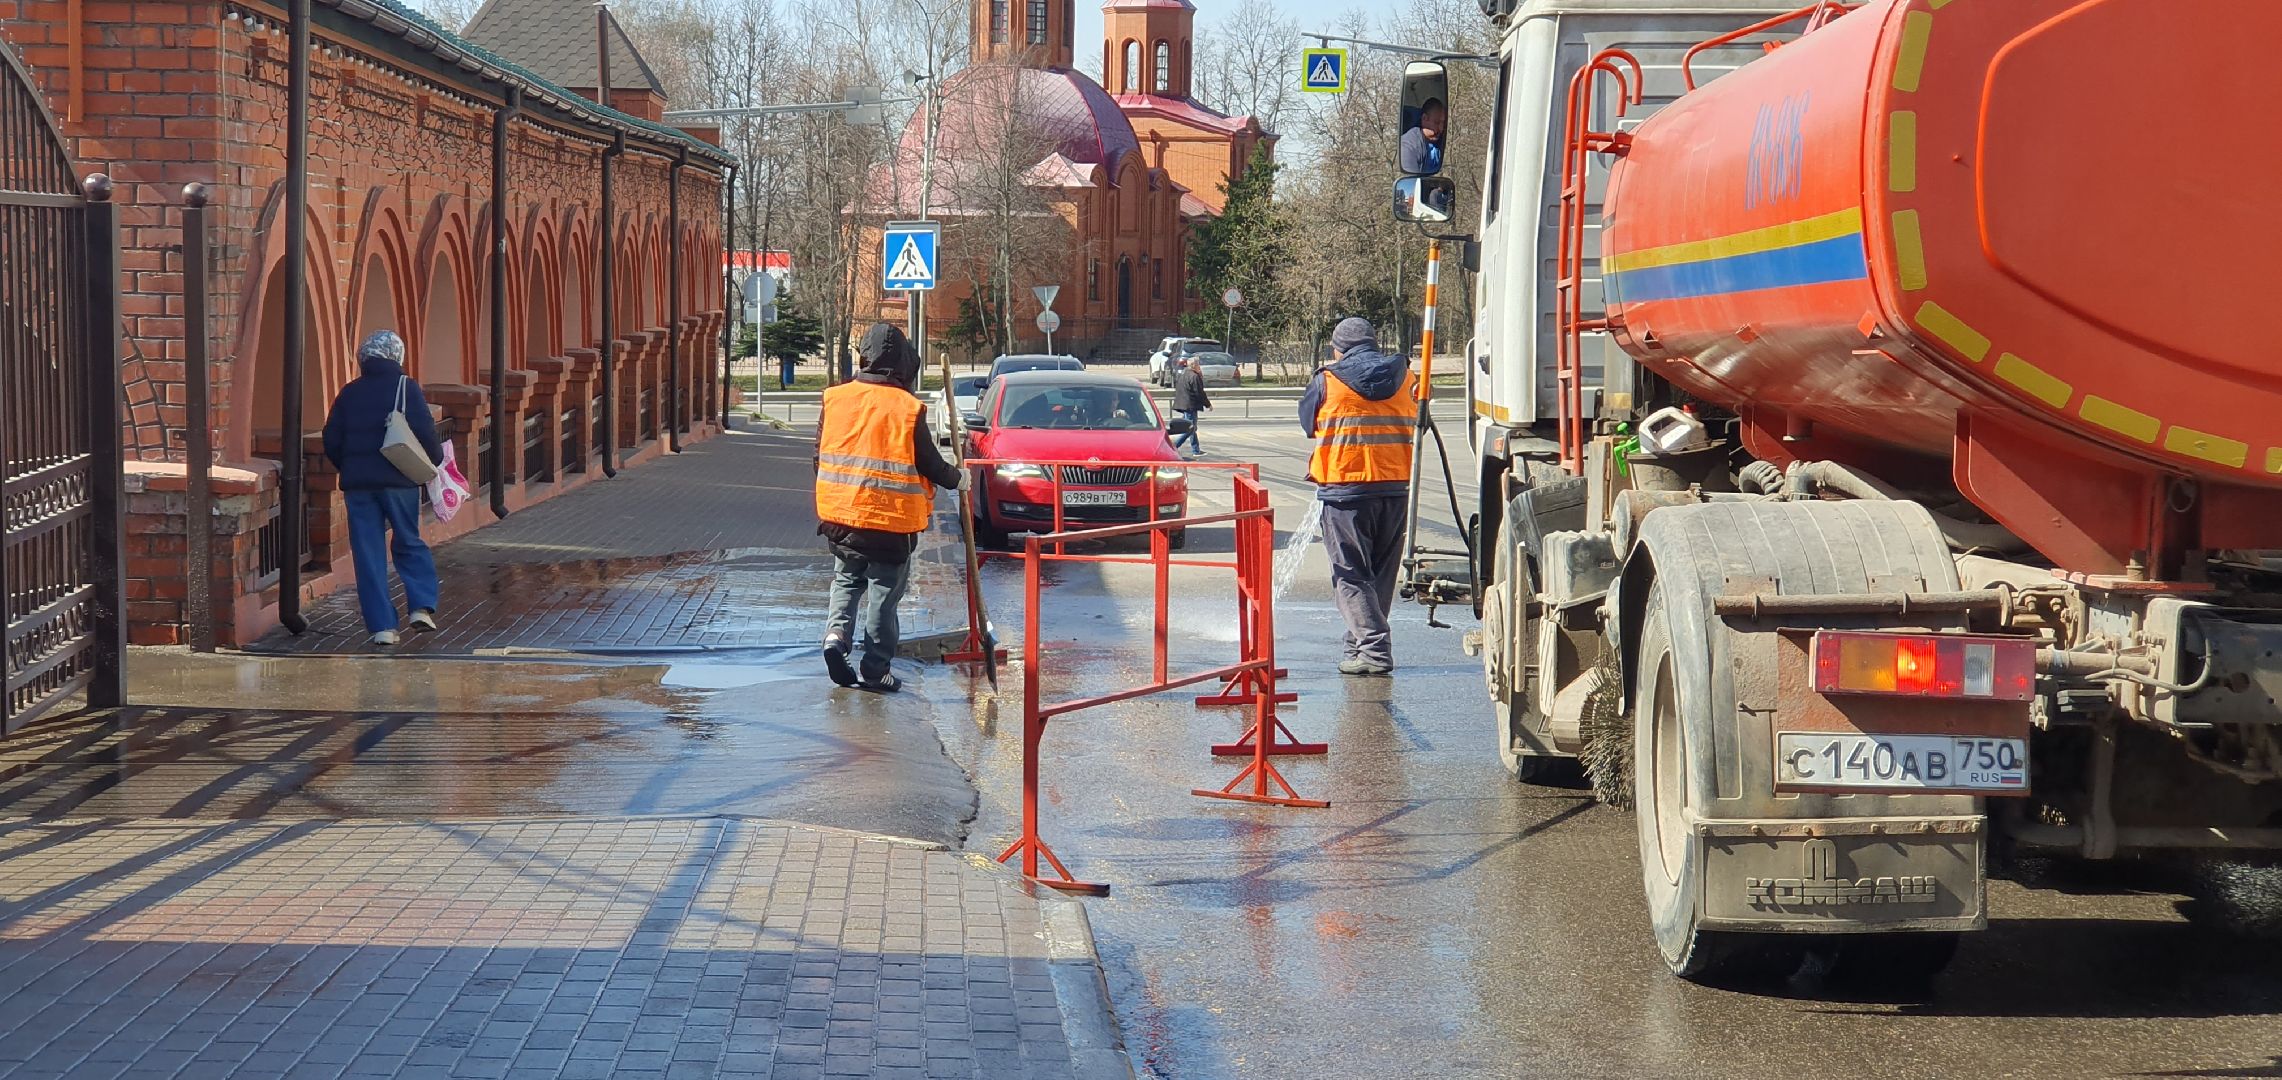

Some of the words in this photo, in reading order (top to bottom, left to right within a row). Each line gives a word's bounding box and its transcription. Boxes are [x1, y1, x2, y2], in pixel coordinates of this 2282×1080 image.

[1792, 740, 1947, 780] С140АВ
[1957, 741, 2015, 771] 750
[1970, 772, 1999, 783] RUS
